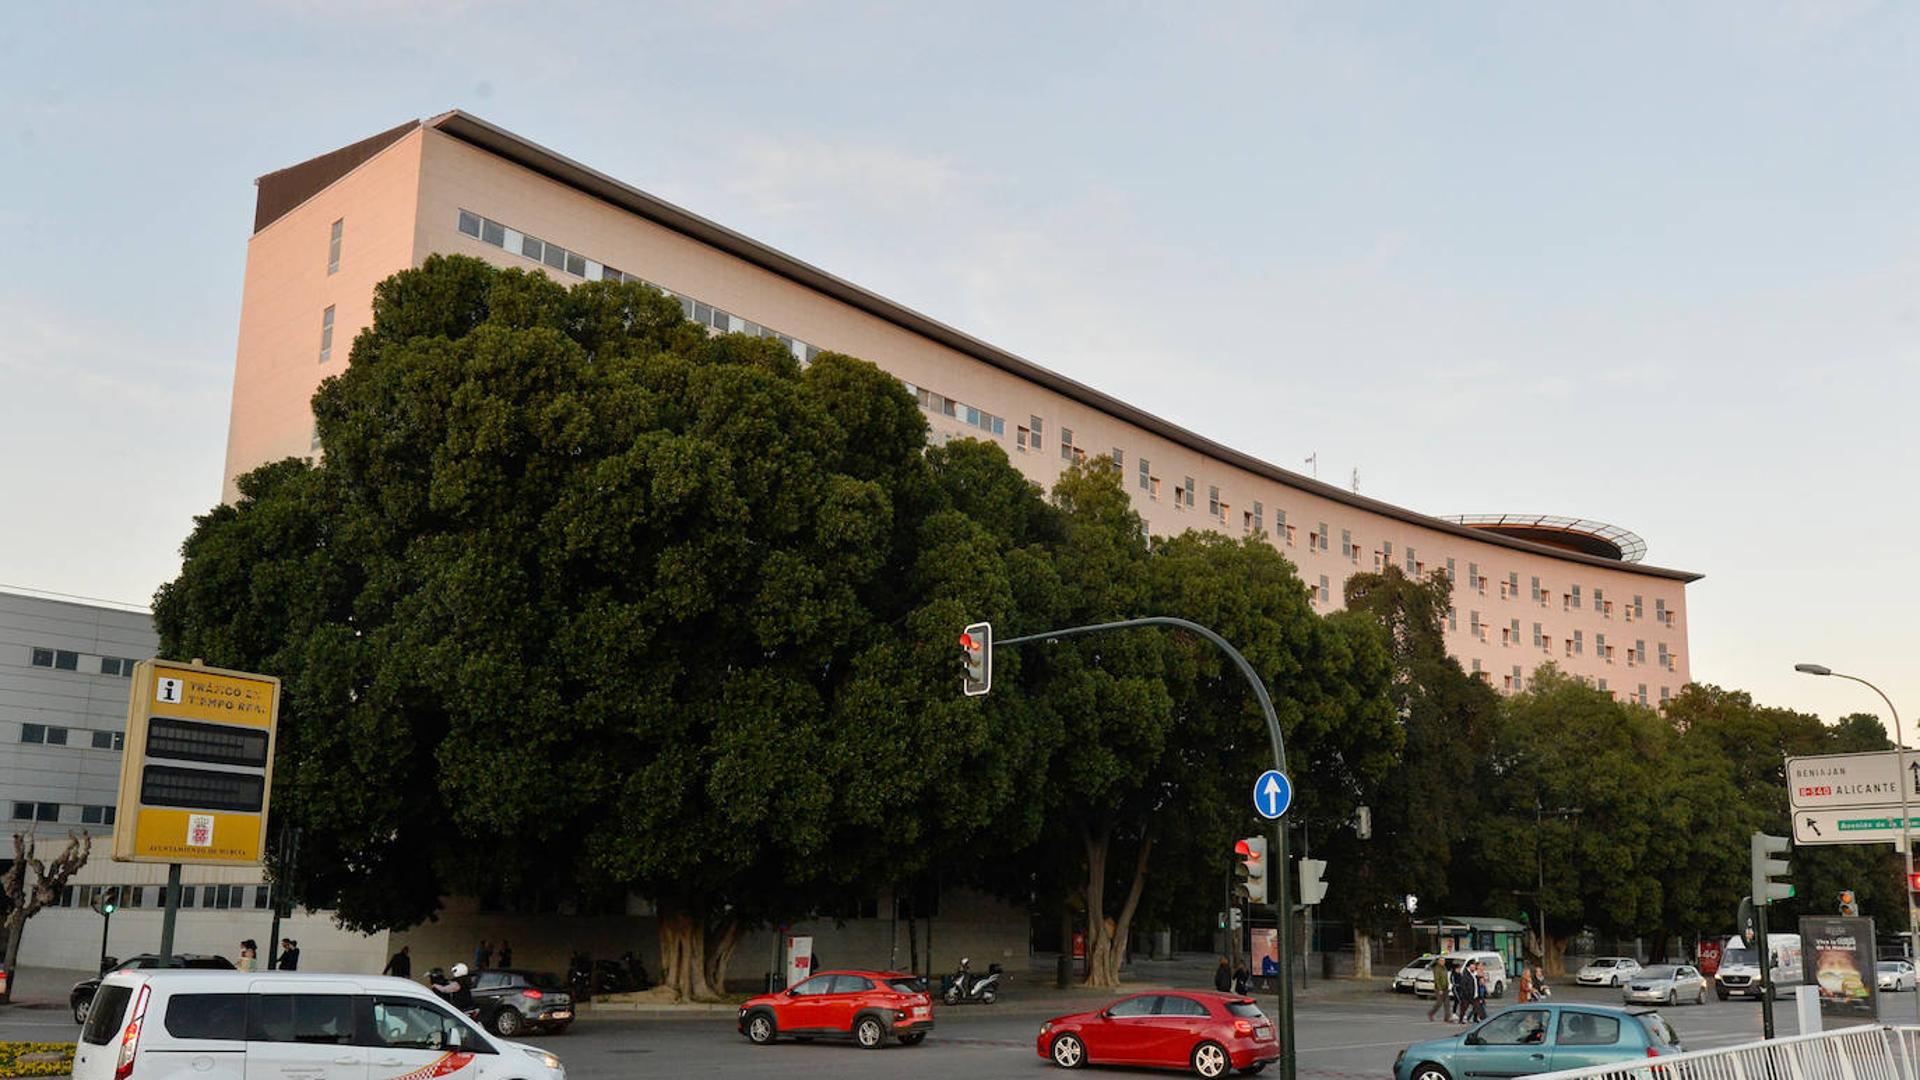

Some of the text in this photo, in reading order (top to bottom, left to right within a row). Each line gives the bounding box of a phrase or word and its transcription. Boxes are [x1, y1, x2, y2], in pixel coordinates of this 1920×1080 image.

[188, 695, 234, 710] TEMPO
[1836, 781, 1896, 795] ALICANTE
[1840, 821, 1873, 830] Avenida
